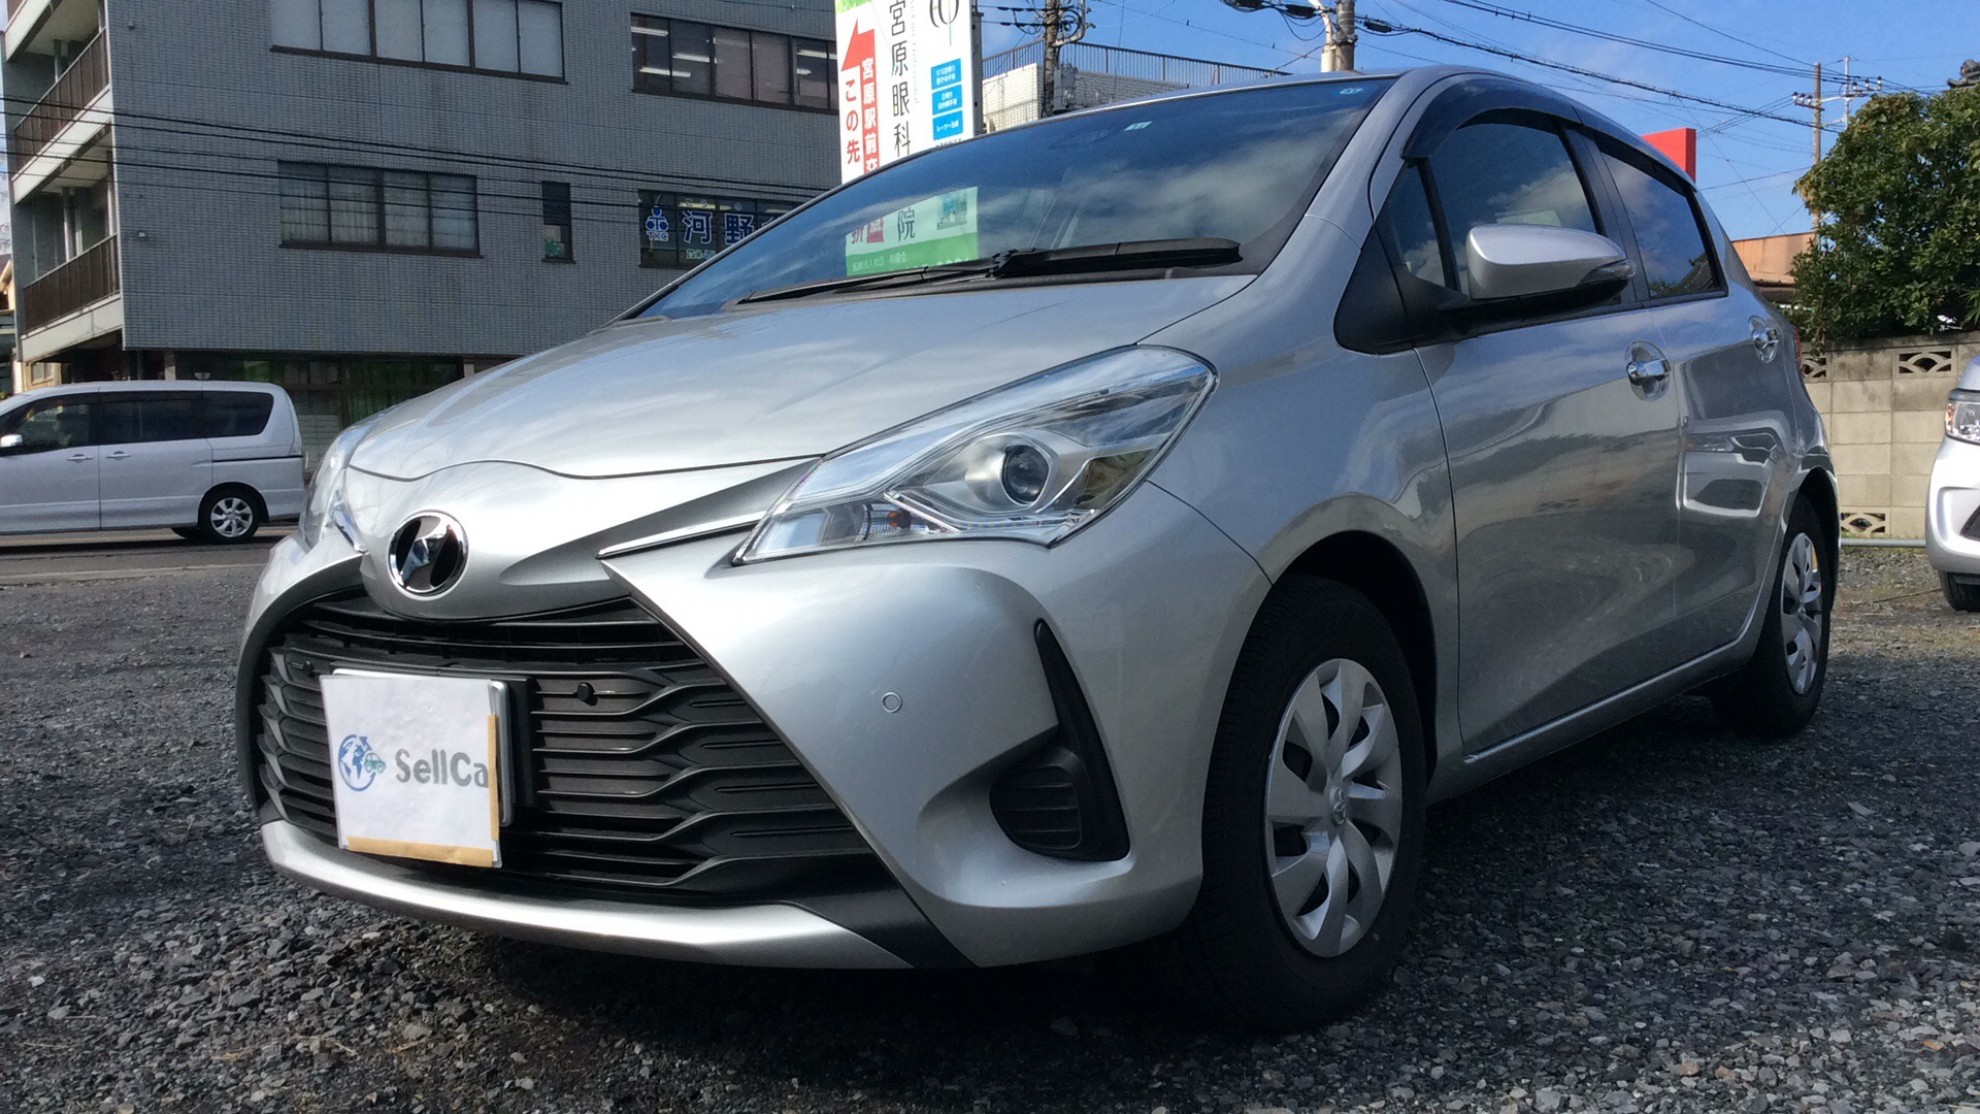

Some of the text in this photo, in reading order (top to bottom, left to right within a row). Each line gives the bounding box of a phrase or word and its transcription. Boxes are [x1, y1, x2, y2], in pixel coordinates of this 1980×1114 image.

[889, 0, 911, 157] 宮原眼科
[845, 79, 861, 164] この先
[898, 208, 915, 241] 院
